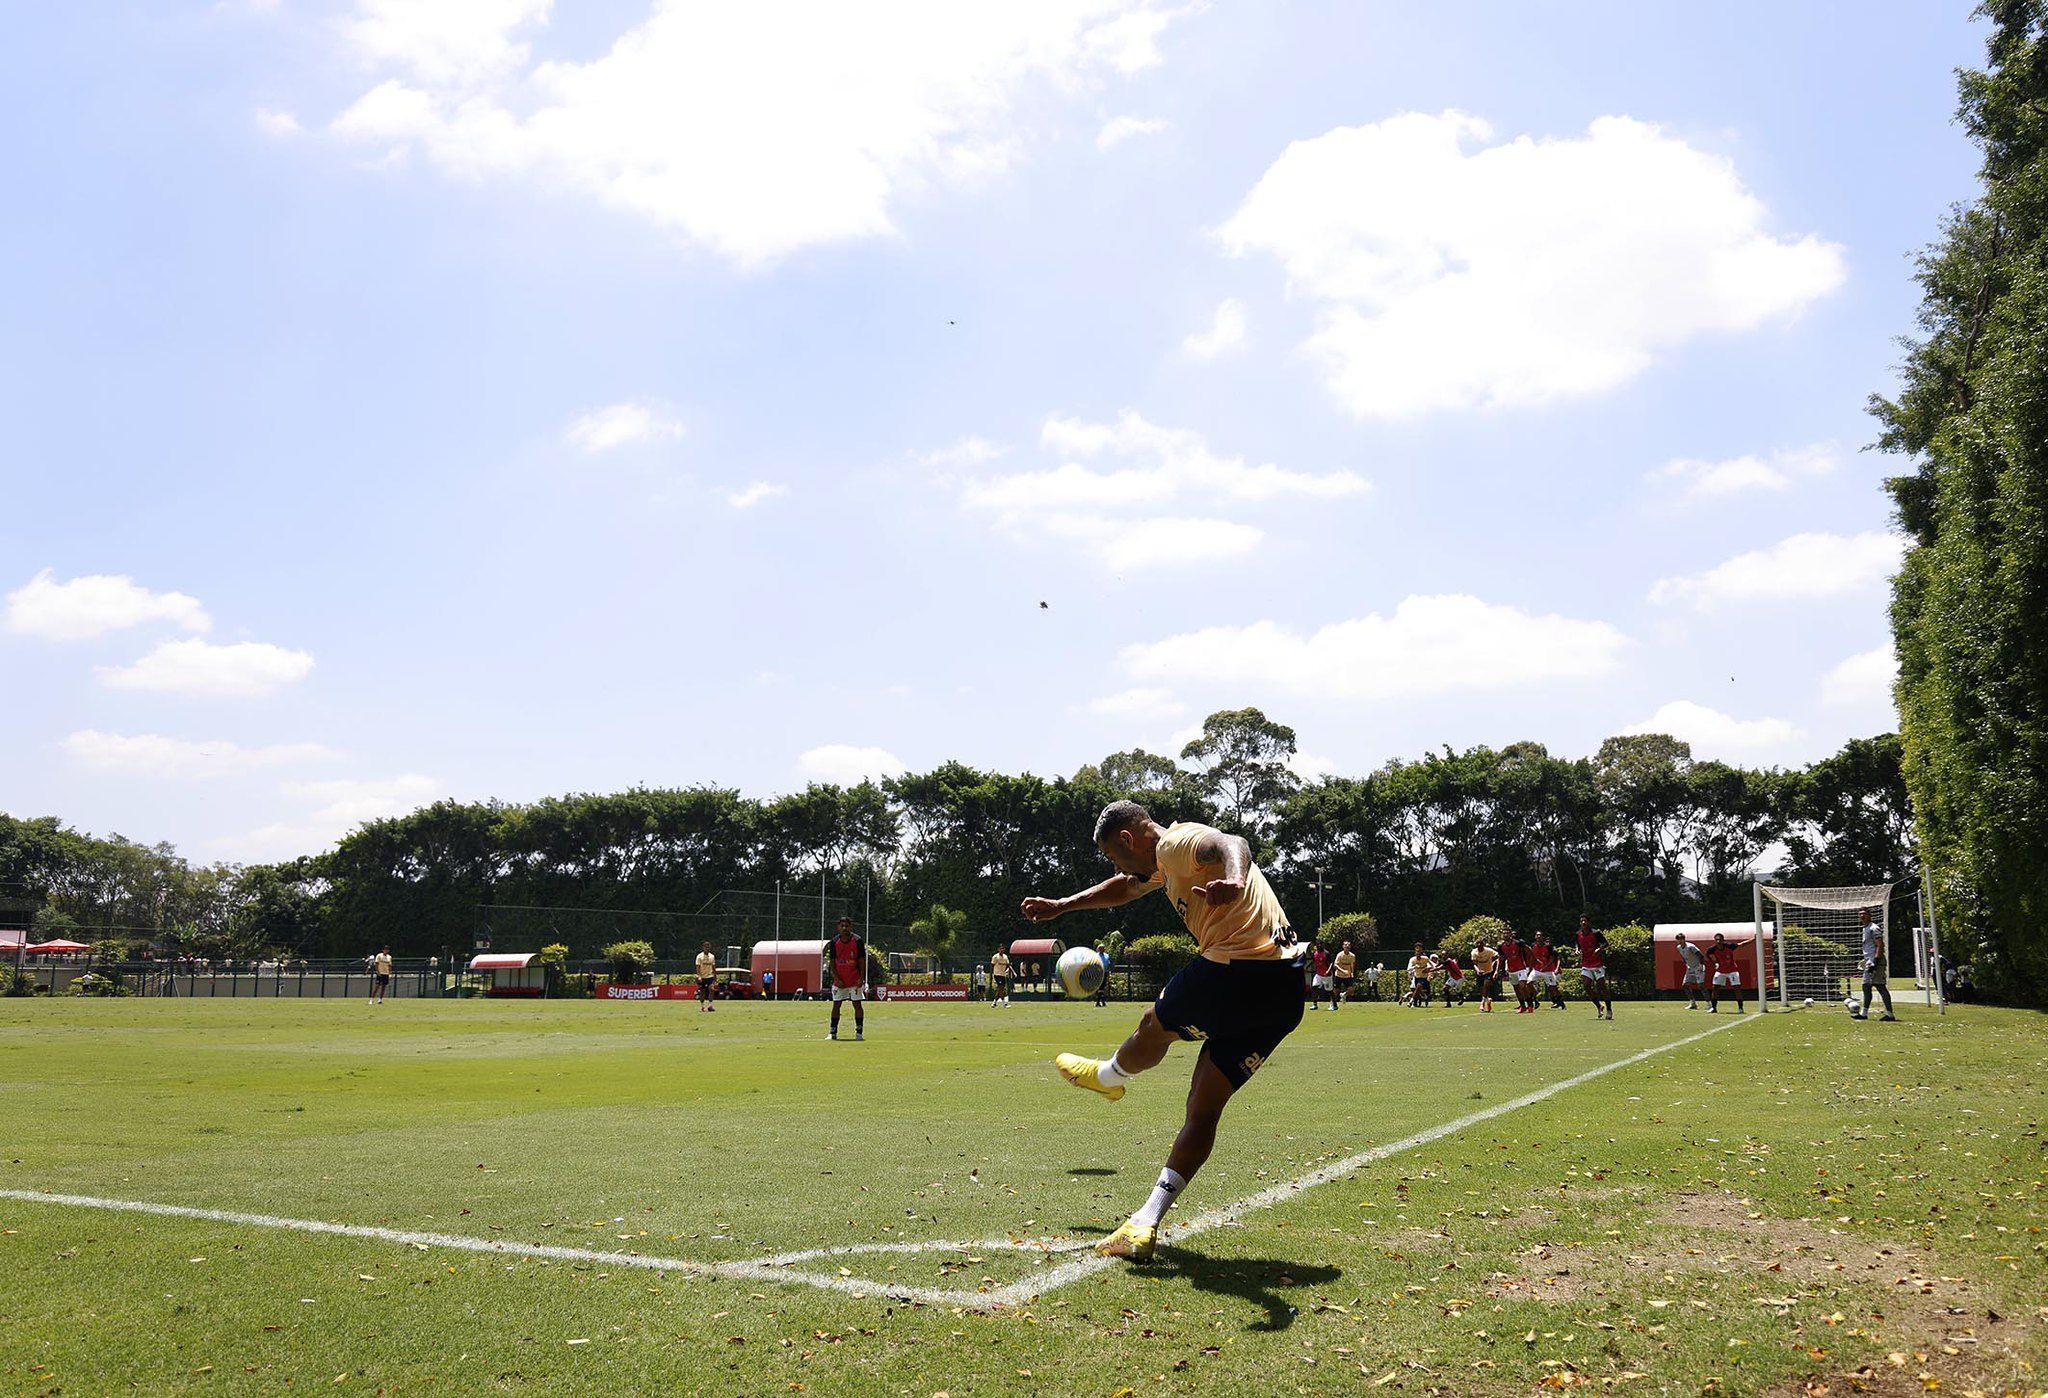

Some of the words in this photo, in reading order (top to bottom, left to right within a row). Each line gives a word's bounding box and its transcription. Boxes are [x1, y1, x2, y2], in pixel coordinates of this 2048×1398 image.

[607, 986, 660, 1000] SUPERBET
[887, 990, 905, 998] SEJA
[905, 989, 926, 998] SÓCIO
